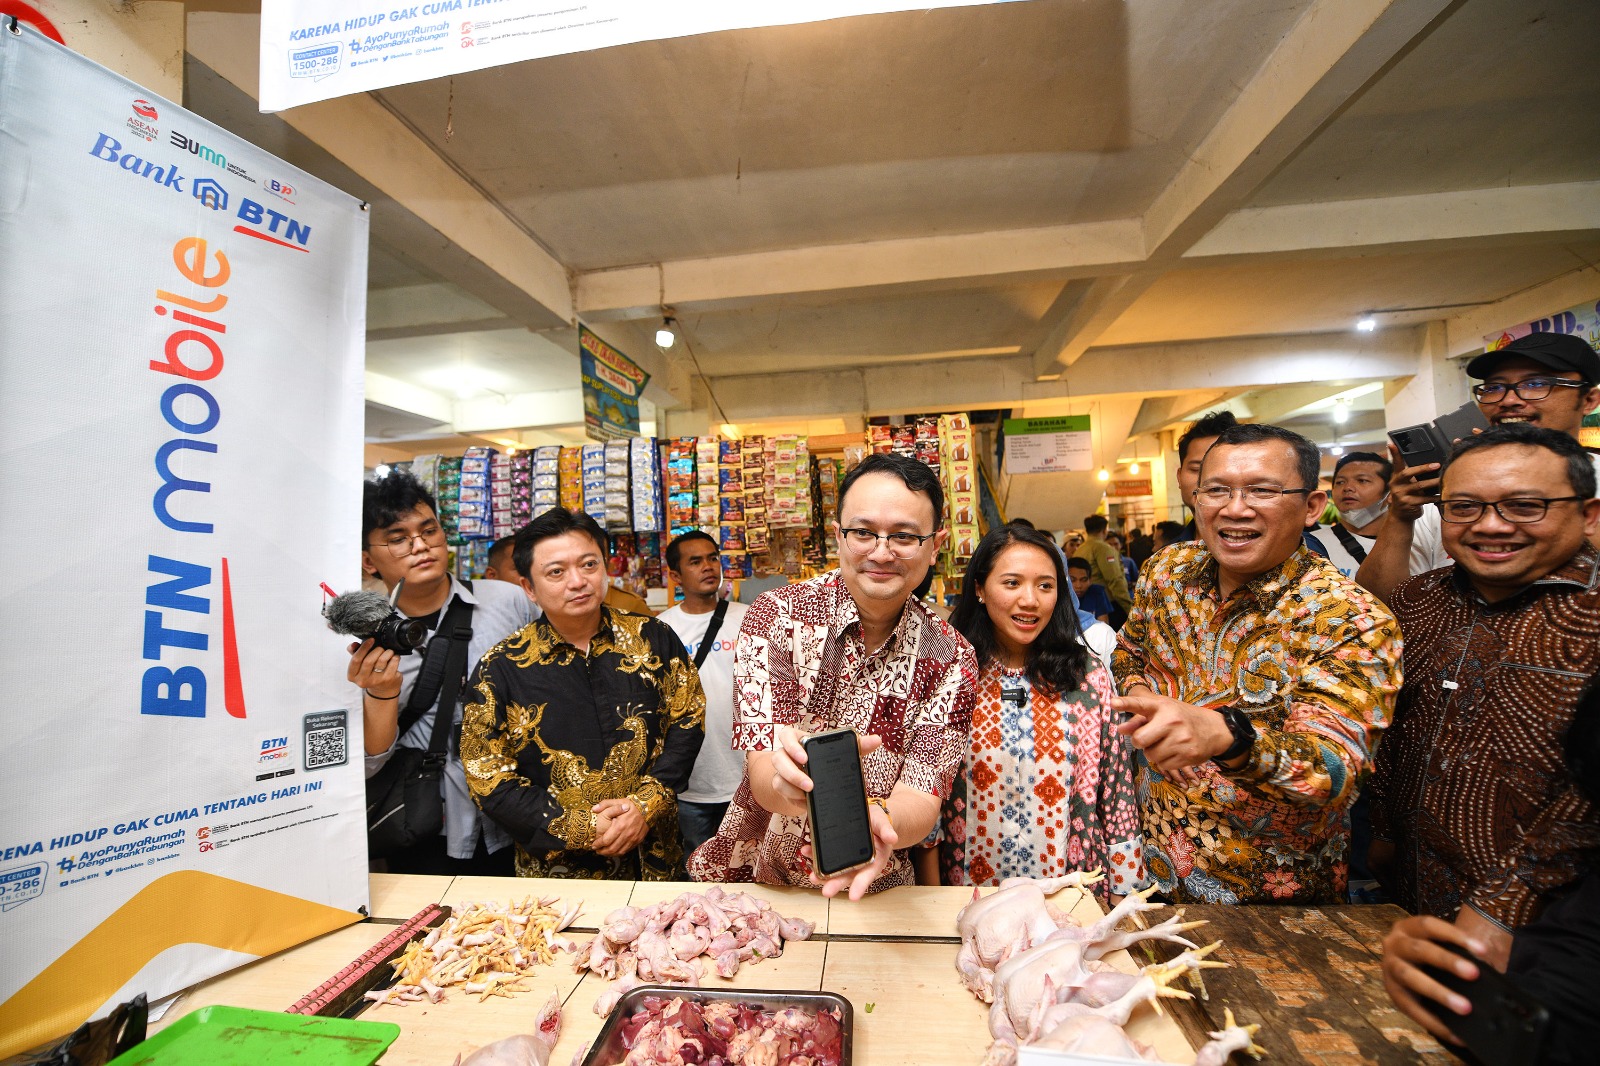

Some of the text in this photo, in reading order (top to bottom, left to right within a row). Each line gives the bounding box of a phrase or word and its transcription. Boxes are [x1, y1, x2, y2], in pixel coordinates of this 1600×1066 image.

[289, 22, 341, 41] KARENA
[344, 13, 386, 31] HIDUP
[389, 6, 419, 22] GAK
[422, 0, 461, 16] CUMA
[364, 21, 450, 45] AyoPunyaRumah
[362, 32, 449, 53] DenganBankTabungan
[293, 56, 338, 70] 1500-286
[126, 122, 158, 140] INDONESIA
[127, 117, 159, 135] ASEAN
[226, 167, 257, 184] INDONESIA
[227, 162, 247, 174] UNTUK
[88, 131, 312, 246] Bank BTN
[140, 236, 232, 719] BTN mobile
[320, 714, 345, 722] Rekening
[261, 737, 288, 749] BTN
[259, 752, 288, 763] mobile
[50, 827, 109, 851] HIDUP
[113, 817, 150, 837] GAK
[153, 807, 200, 828] CUMA
[203, 792, 267, 815] TENTANG
[270, 785, 301, 801] HARI
[304, 781, 323, 793] INI
[77, 839, 185, 870] DenganBankTabungan
[79, 829, 186, 862] AyoPunyaRumah
[7, 869, 36, 881] CENTER
